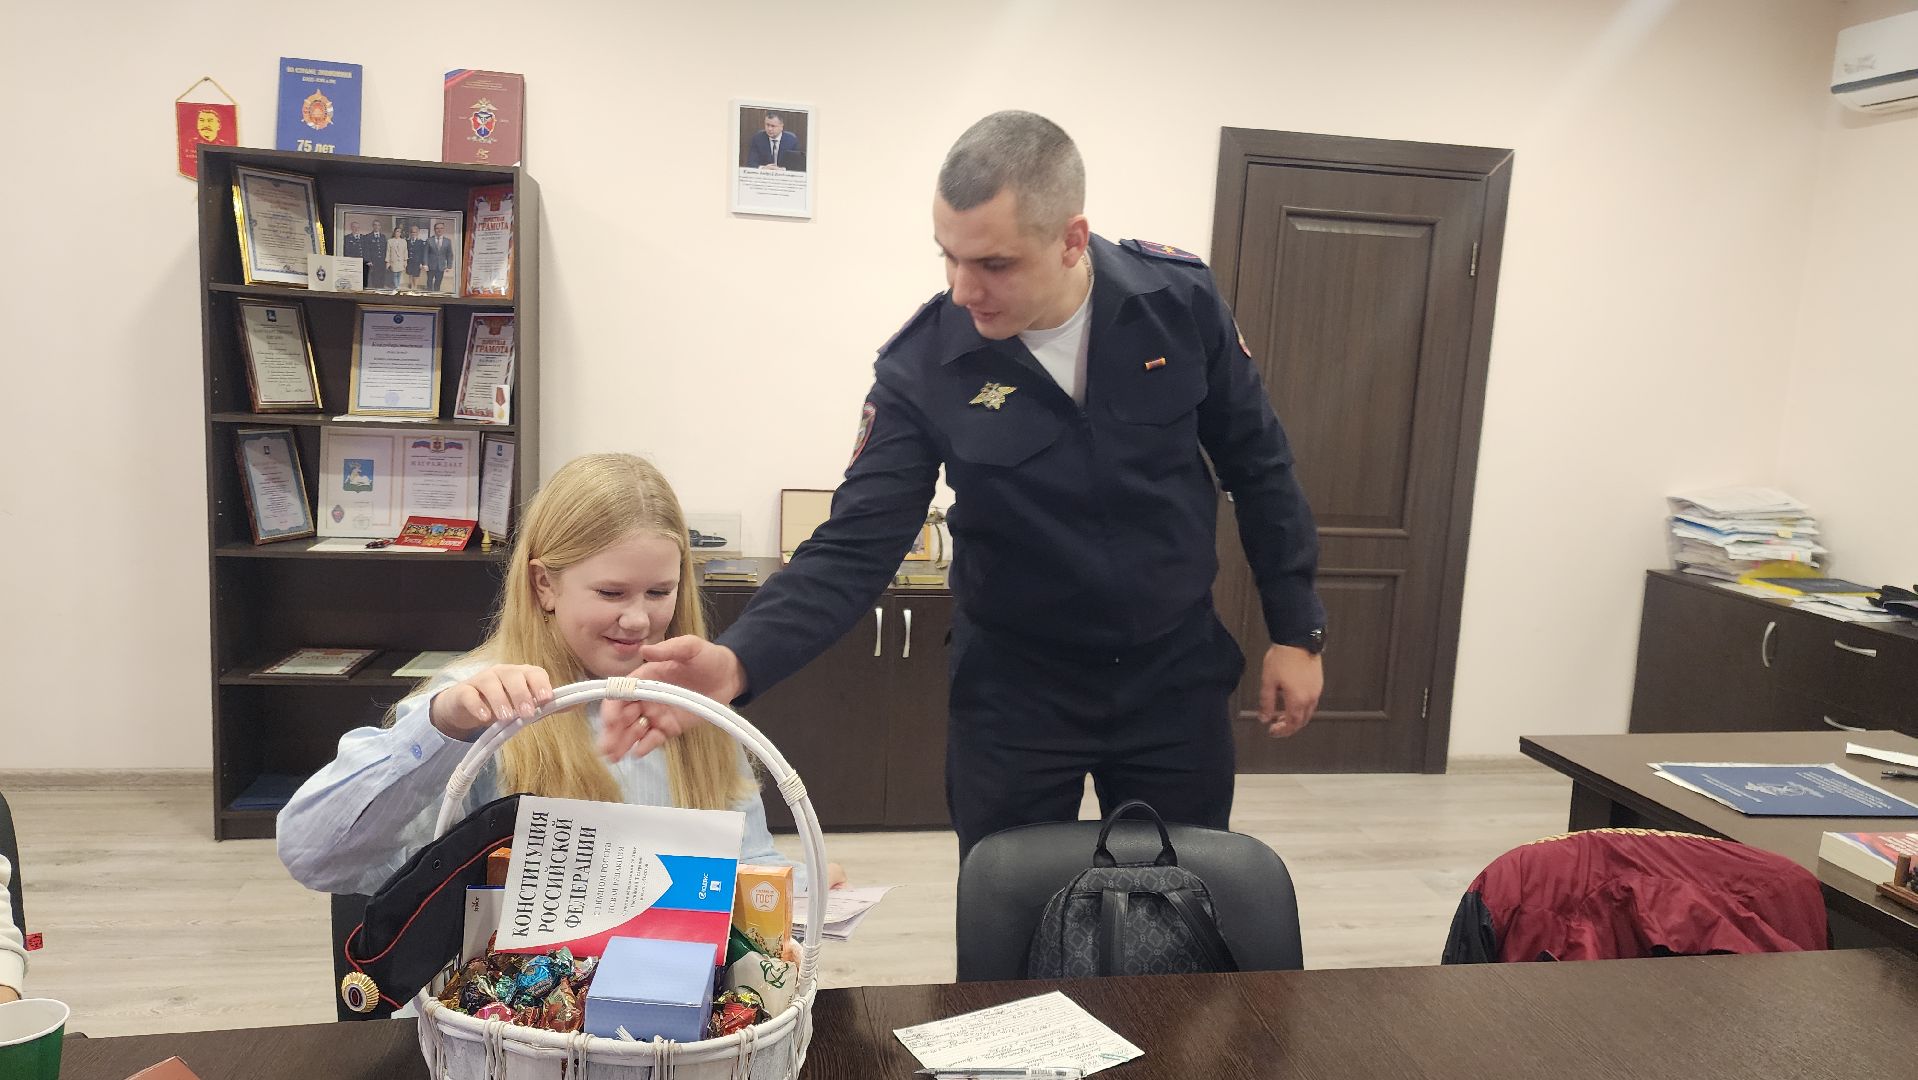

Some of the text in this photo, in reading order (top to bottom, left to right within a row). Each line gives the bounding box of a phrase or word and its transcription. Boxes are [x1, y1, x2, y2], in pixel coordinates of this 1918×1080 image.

[297, 139, 335, 154] 75 лет
[474, 344, 510, 354] ГРАМОТА
[512, 811, 549, 937] КОНСТИТУЦИЯ
[538, 818, 573, 933] РОССИЙСКОЙ
[564, 826, 597, 928] ФЕДЕРАЦИИ
[755, 893, 774, 904] ГОСТ
